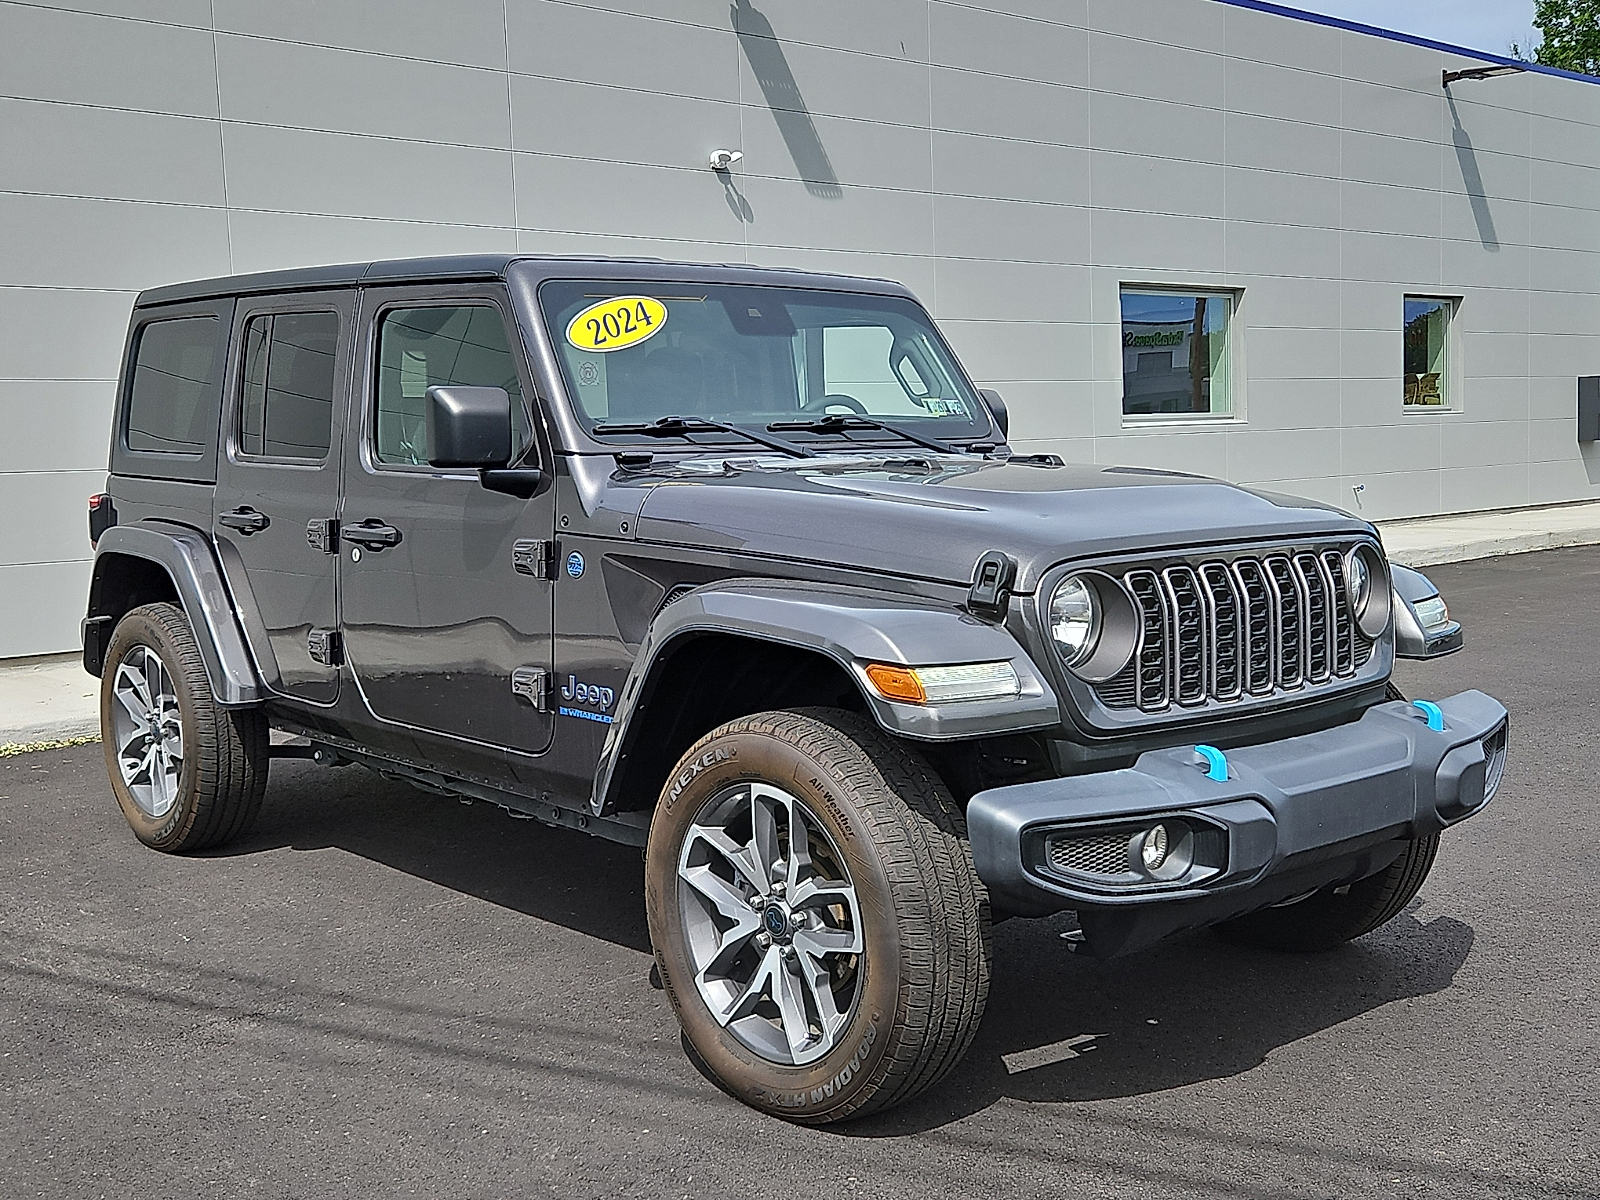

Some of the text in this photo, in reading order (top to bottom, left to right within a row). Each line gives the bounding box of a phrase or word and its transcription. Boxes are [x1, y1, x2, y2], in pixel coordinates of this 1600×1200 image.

[587, 301, 653, 345] 2024
[561, 674, 613, 712] Jeep
[669, 746, 730, 802] NEXEN
[808, 777, 856, 838] All-Weather
[810, 1019, 877, 1104] ROADIAN
